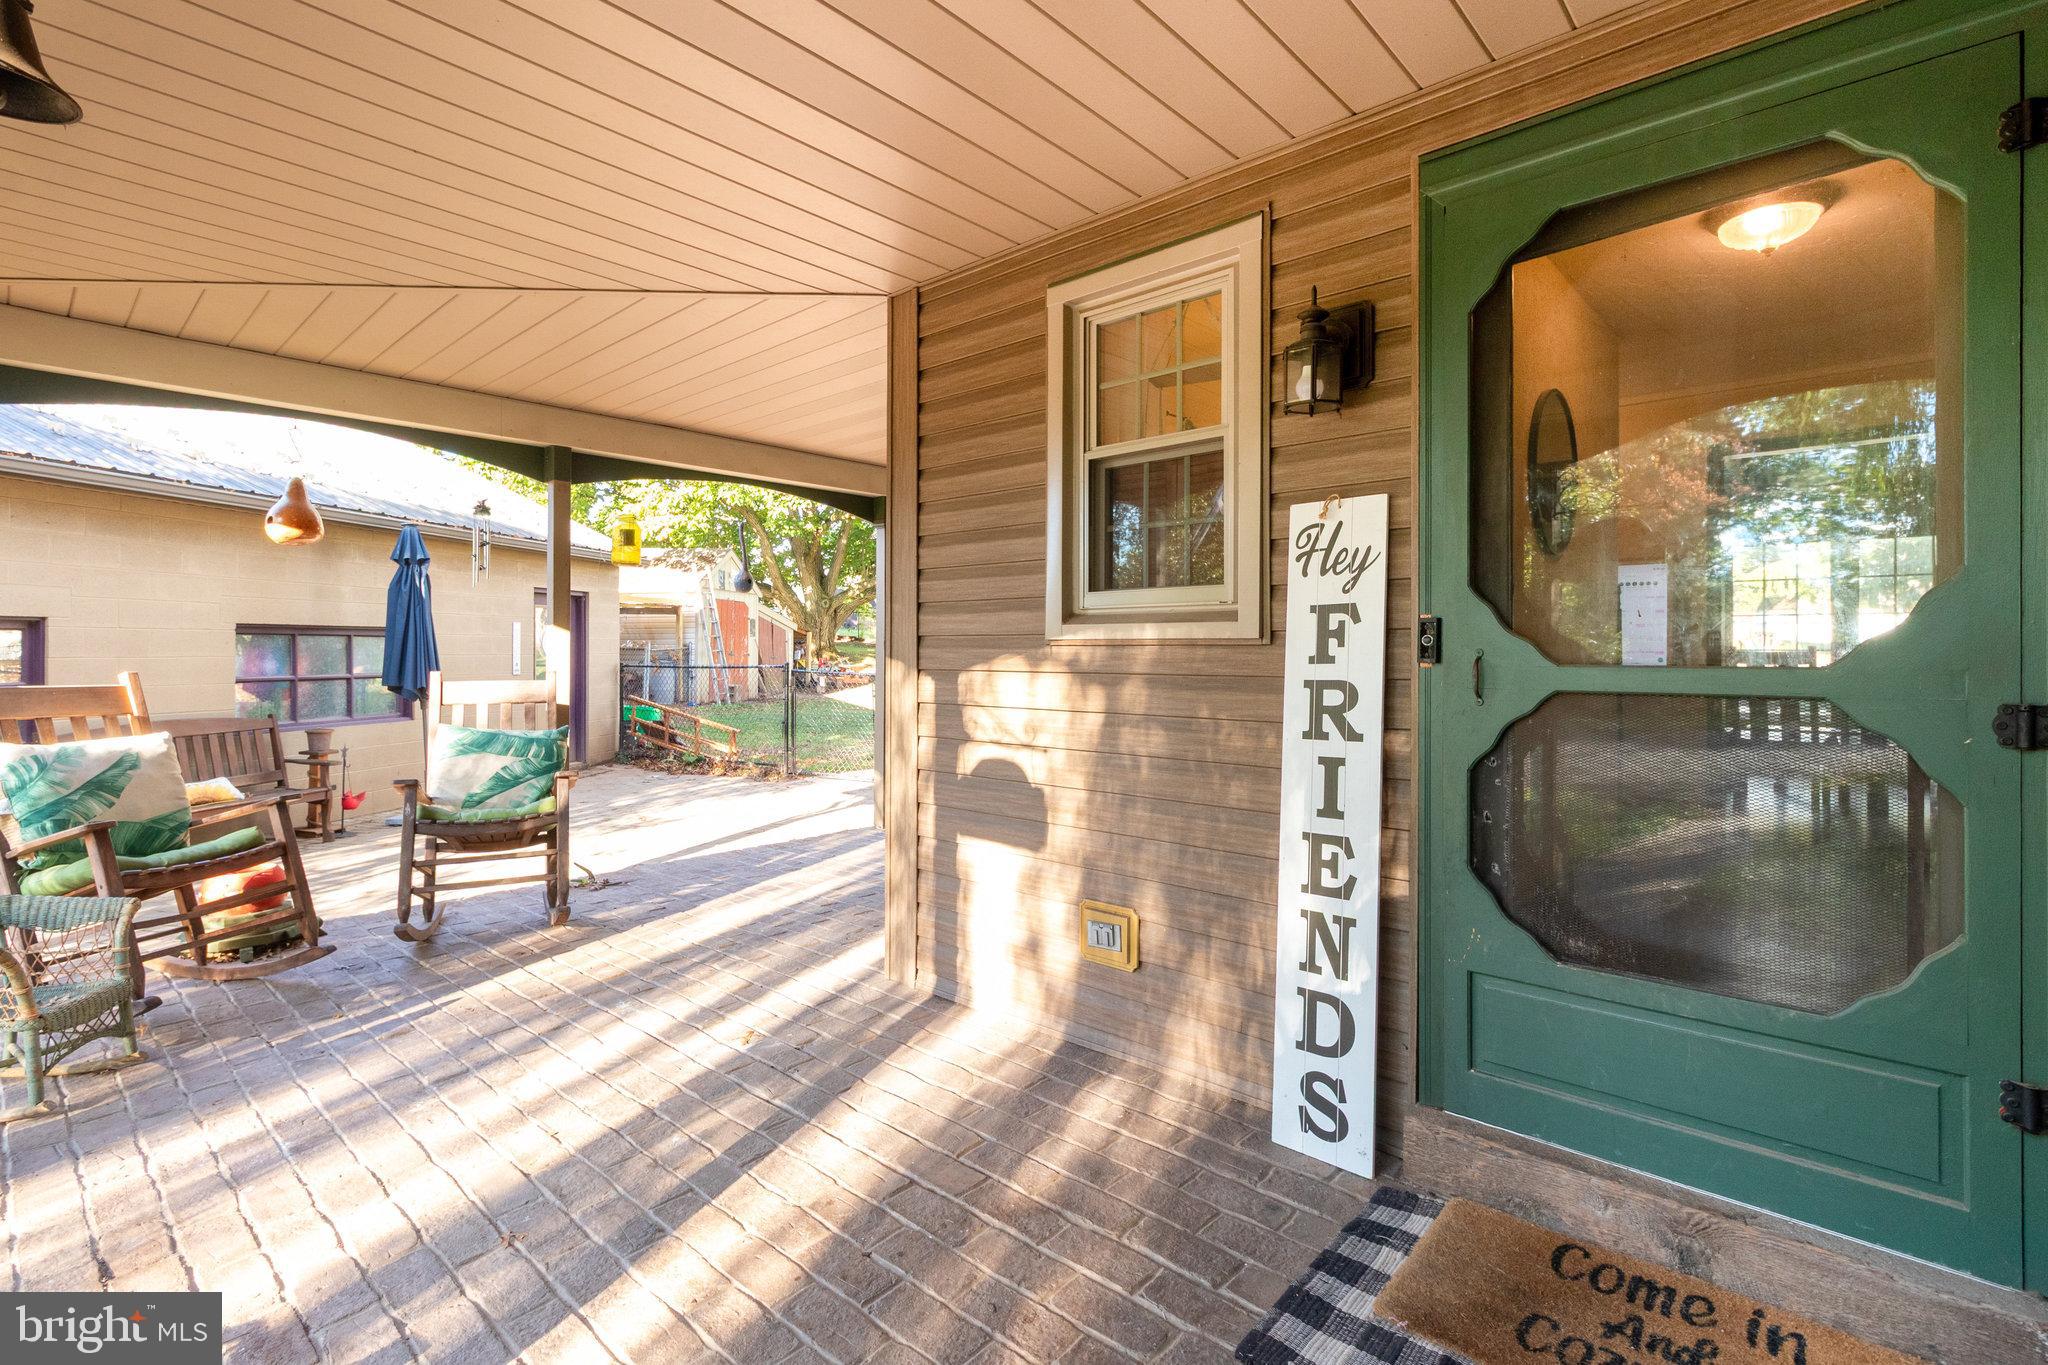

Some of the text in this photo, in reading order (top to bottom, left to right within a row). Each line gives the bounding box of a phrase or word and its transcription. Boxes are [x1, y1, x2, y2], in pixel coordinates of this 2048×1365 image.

[1295, 520, 1382, 594] Hey
[1295, 602, 1364, 1143] FRIENDS
[1551, 1243, 1806, 1365] Come in
